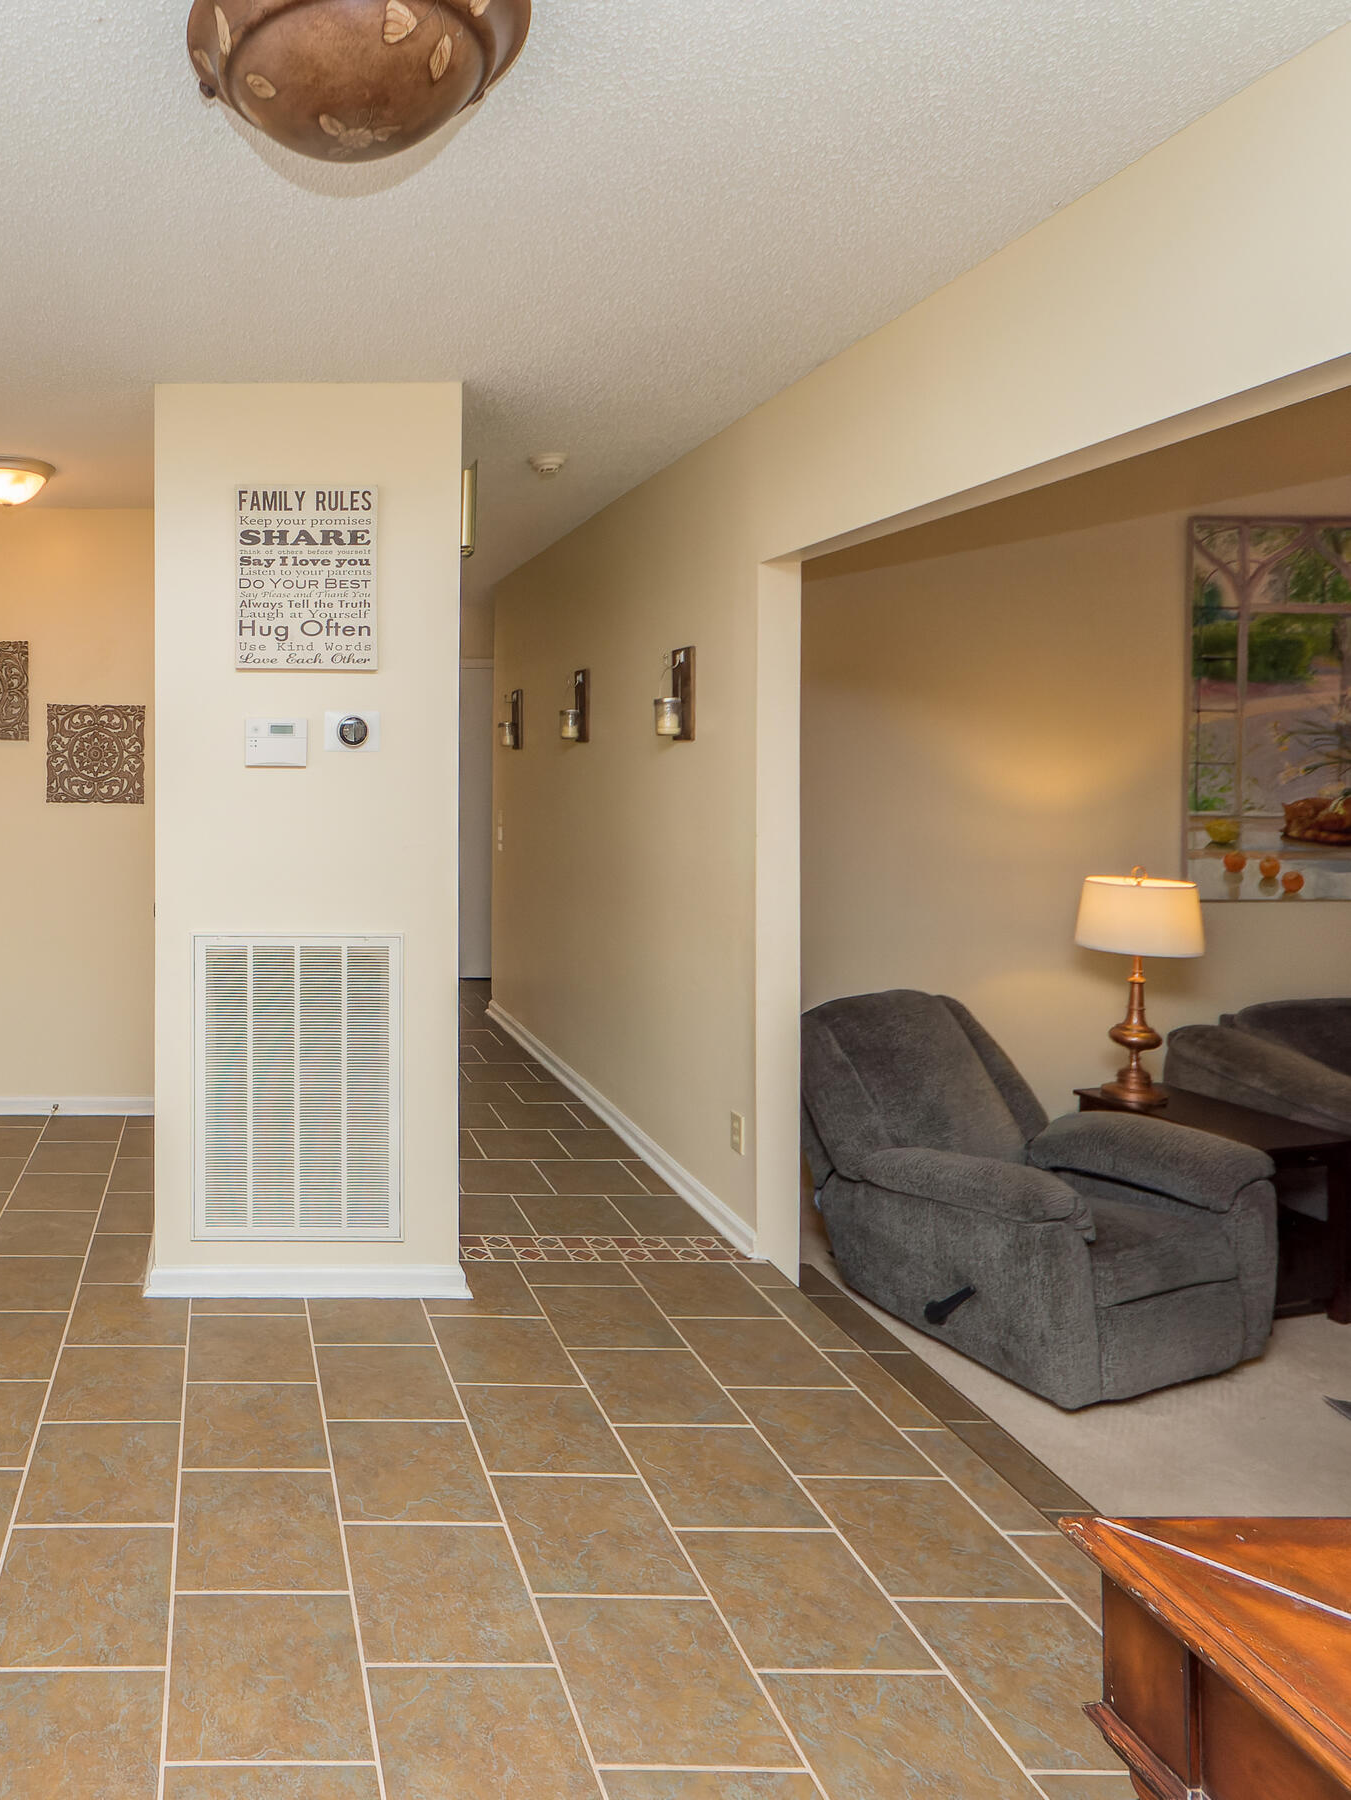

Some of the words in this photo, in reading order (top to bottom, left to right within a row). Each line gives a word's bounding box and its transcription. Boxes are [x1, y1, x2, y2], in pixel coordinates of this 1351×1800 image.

[238, 490, 306, 511] FAMILY
[315, 490, 372, 511] RULES
[239, 516, 272, 527] Keep
[276, 518, 306, 528] your
[310, 516, 372, 528] promises
[239, 529, 371, 546] SHARE
[239, 556, 276, 568] Say
[279, 556, 289, 566] I
[291, 556, 331, 566] love
[335, 558, 371, 568] you
[240, 567, 276, 576] Listen
[280, 568, 292, 576] to
[295, 569, 324, 578] your
[327, 568, 372, 578] parents
[324, 578, 372, 589] BEST
[239, 591, 259, 599] Say
[239, 599, 284, 610] Always
[287, 599, 309, 608] Tell
[314, 599, 334, 608] the
[338, 599, 371, 608] Truth
[239, 609, 284, 620] Laugh
[290, 610, 303, 618] at
[308, 609, 371, 618] Yourself
[238, 620, 289, 641] Hug
[300, 619, 371, 636] Often
[239, 642, 266, 651] Use
[277, 642, 314, 651] Kind
[324, 642, 371, 651] Words
[239, 653, 278, 664] Love
[286, 653, 324, 664] Each
[331, 653, 371, 664] Other
